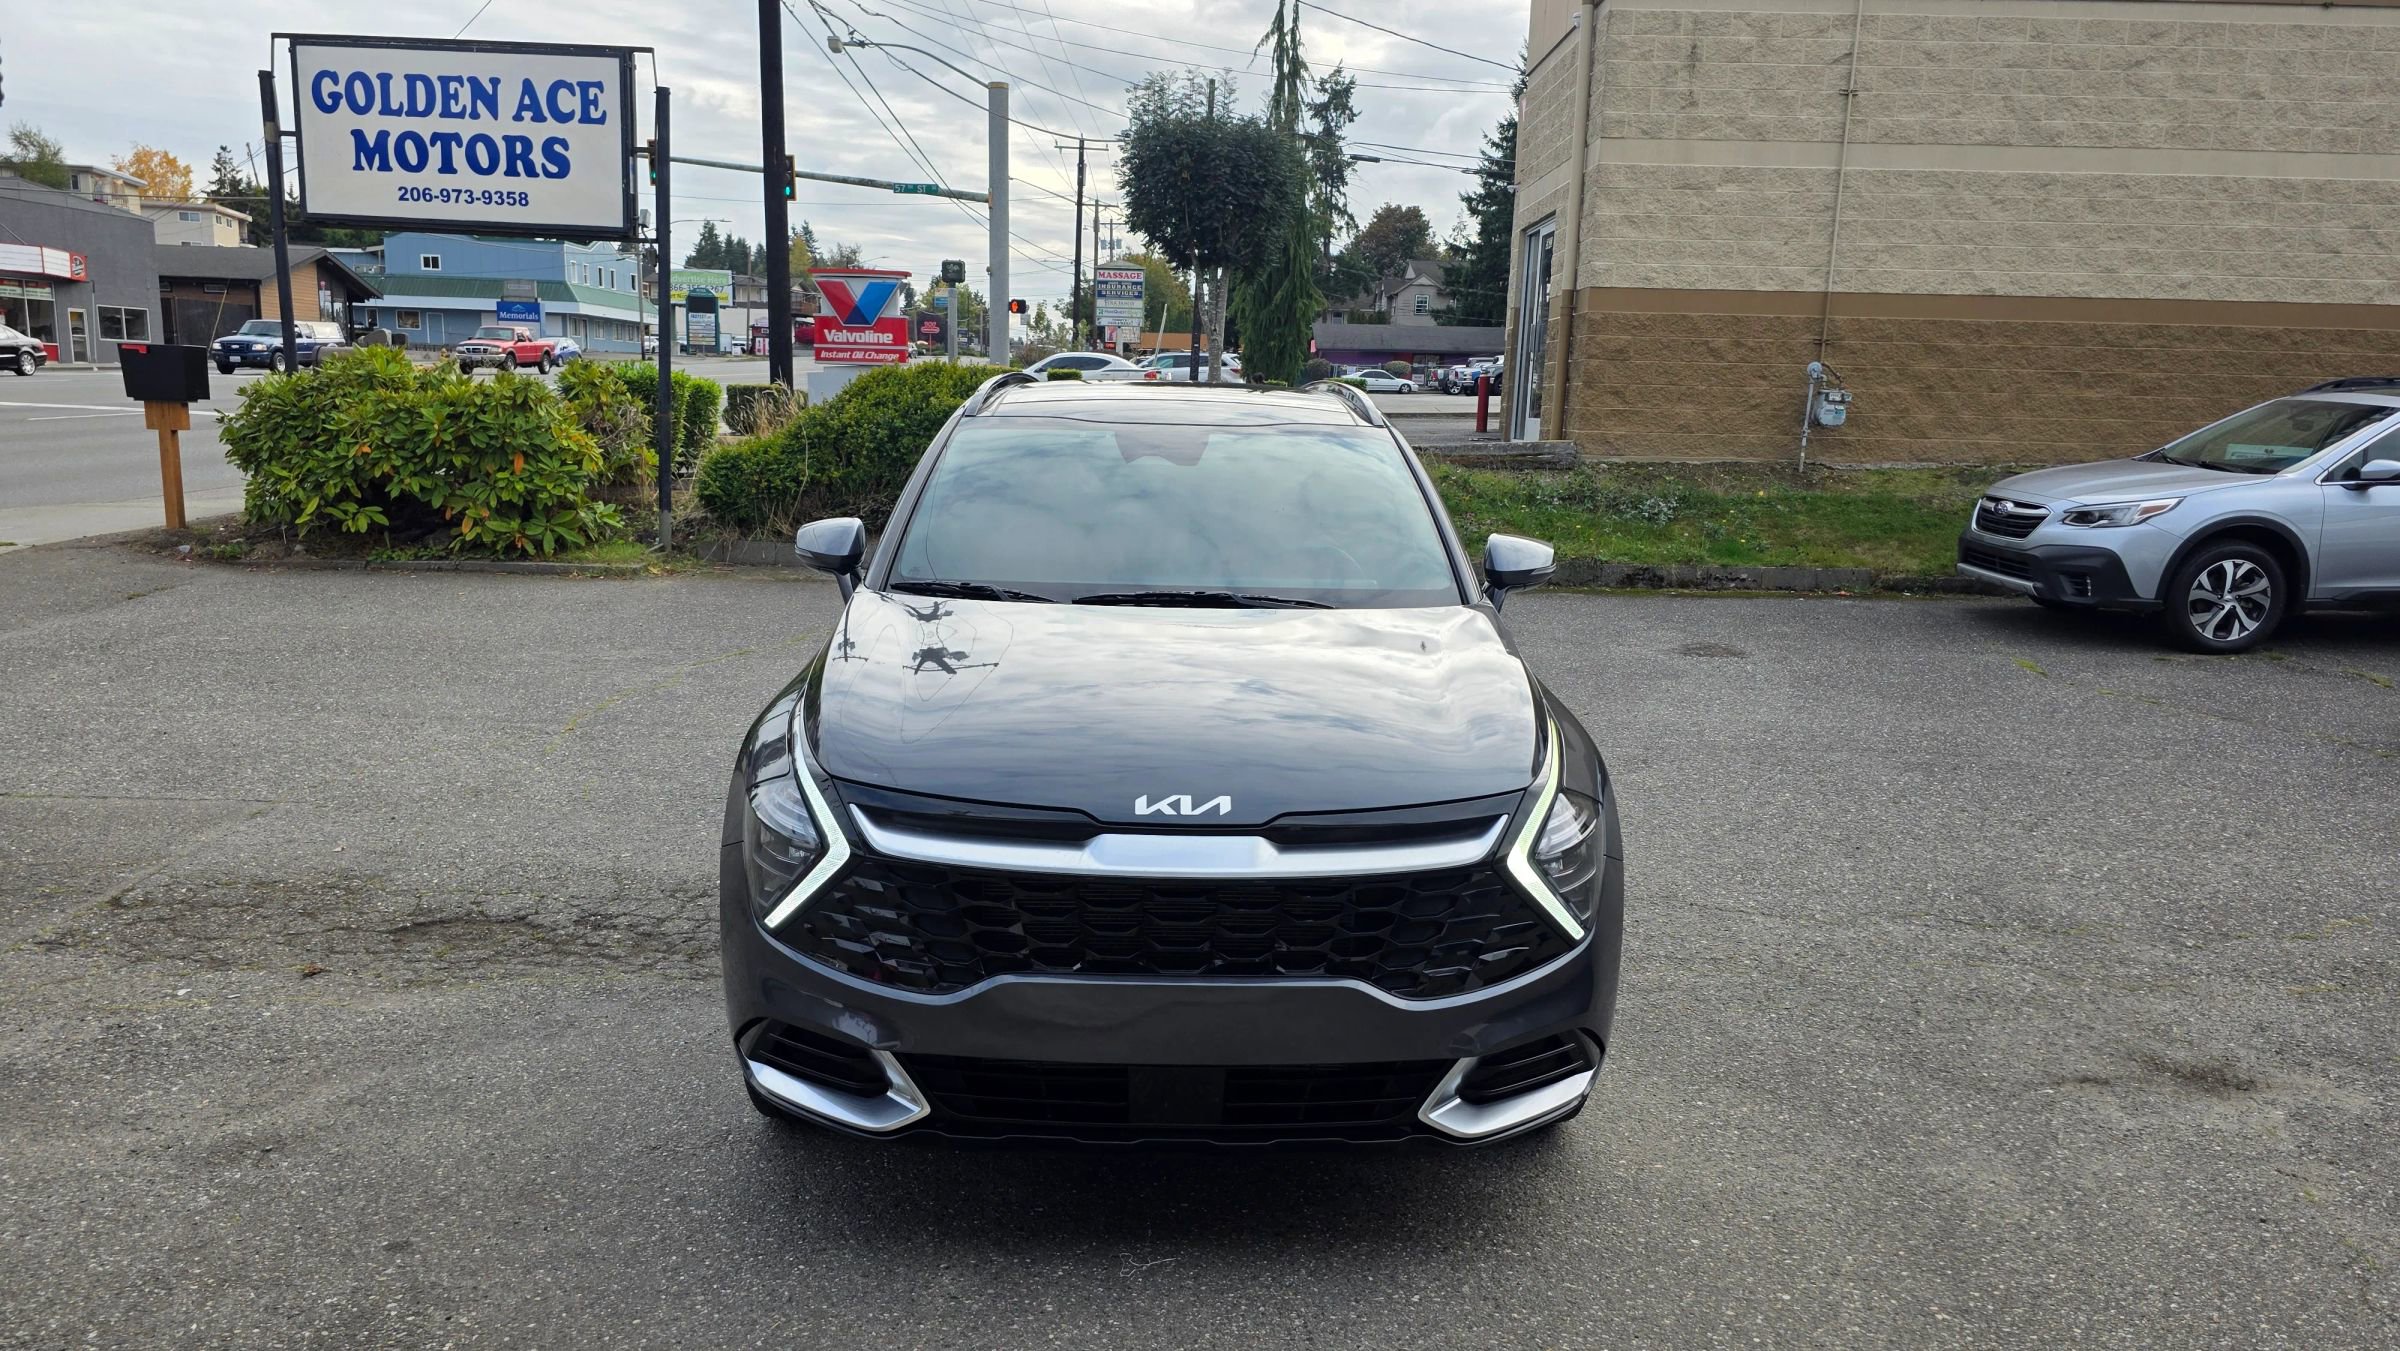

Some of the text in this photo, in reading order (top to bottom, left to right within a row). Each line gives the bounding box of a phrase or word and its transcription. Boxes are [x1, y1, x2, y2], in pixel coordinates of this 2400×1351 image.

[312, 70, 607, 125] GOLDEN ACE
[351, 129, 571, 179] MOTORS
[895, 184, 906, 192] 57
[917, 184, 927, 193] ST
[398, 186, 529, 207] 206-973-9358
[1098, 271, 1142, 280] MASSAGE
[500, 311, 539, 320] Memorials
[823, 329, 894, 344] Valvoline
[821, 350, 899, 361] Instant Oil Change
[1135, 795, 1231, 815] KIA
